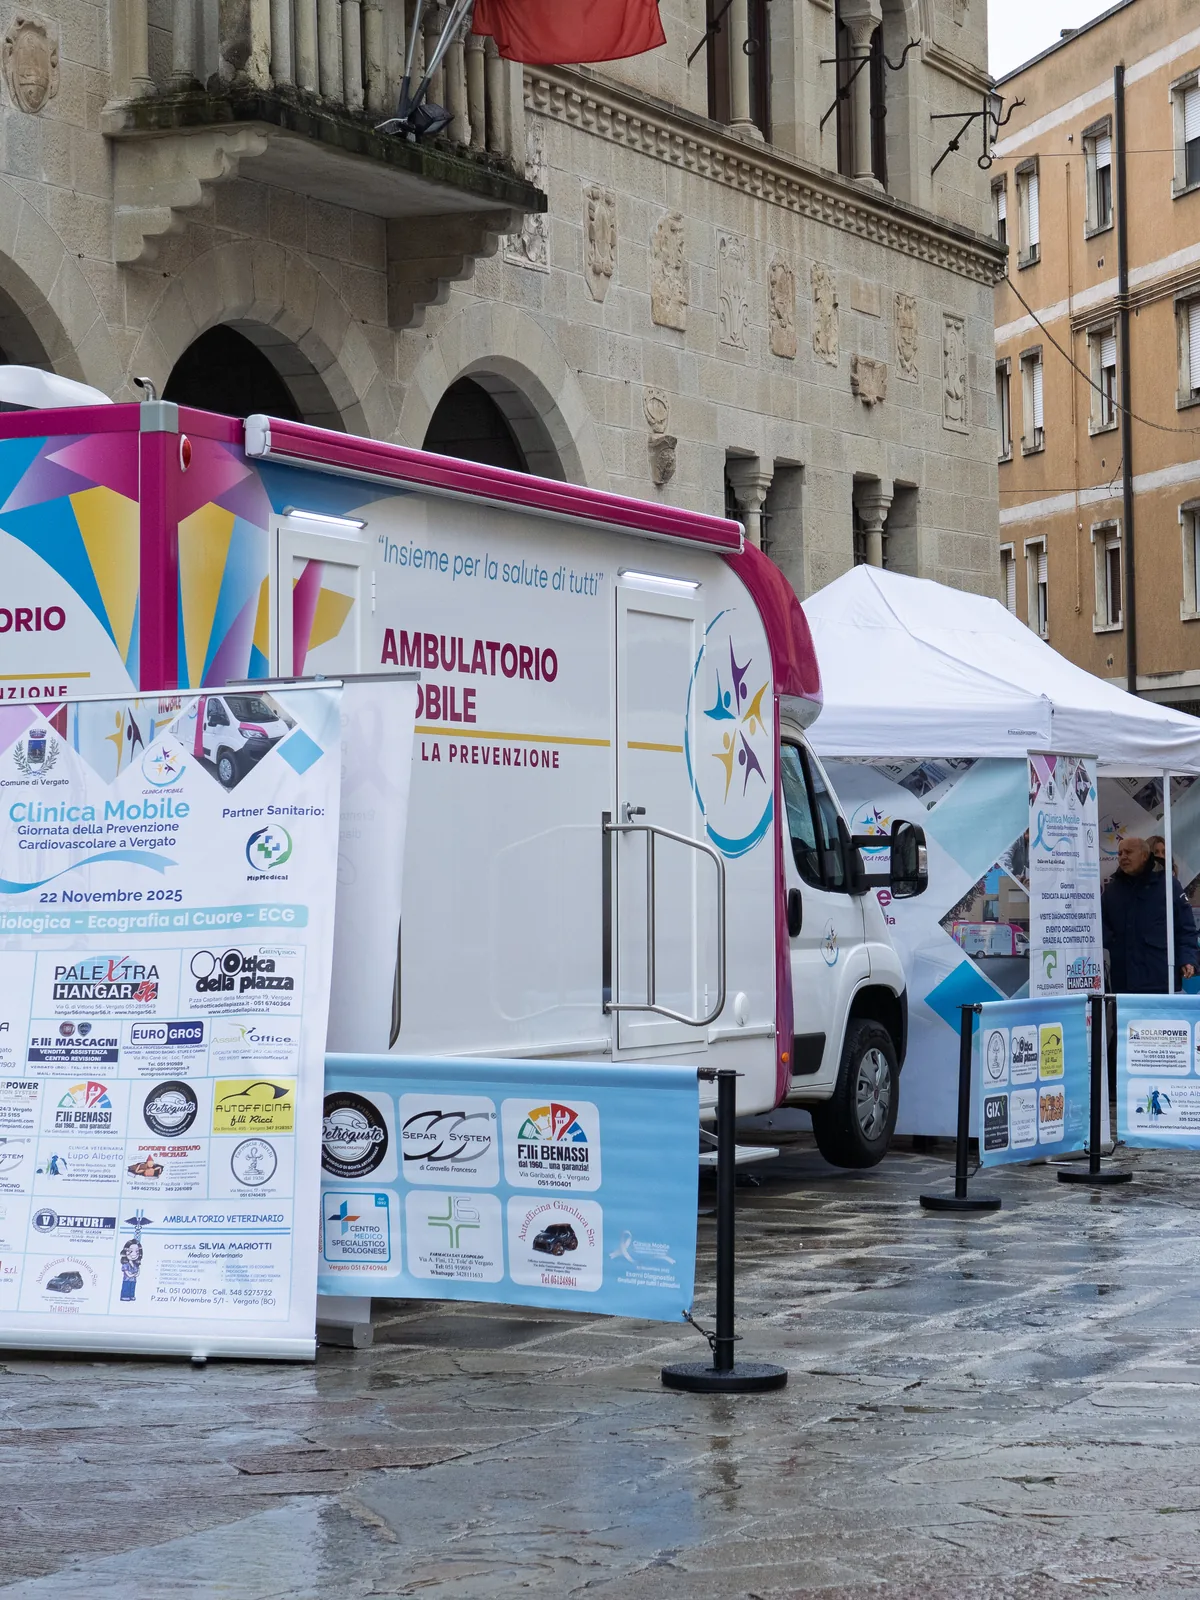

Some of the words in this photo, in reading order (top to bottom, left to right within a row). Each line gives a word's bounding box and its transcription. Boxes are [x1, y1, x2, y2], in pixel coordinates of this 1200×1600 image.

[378, 535, 449, 573] “Insieme
[453, 555, 480, 581] per
[484, 553, 499, 580] la
[502, 560, 548, 588] salute
[552, 566, 565, 591] di
[569, 571, 604, 596] tutti”
[381, 628, 558, 683] AMBULATORIO
[422, 742, 441, 762] LA
[449, 744, 560, 769] PREVENZIONE
[0, 779, 30, 787] Comune
[40, 778, 70, 787] Vergato
[9, 801, 96, 823] Clinica
[103, 797, 190, 821] Mobile
[222, 807, 264, 818] Partner
[266, 805, 325, 816] Sanitario:
[1044, 813, 1062, 824] Clinica
[1062, 814, 1081, 825] Mobile
[17, 824, 70, 836] Giornata
[72, 823, 103, 835] della
[106, 821, 179, 834] Prevenzione
[18, 838, 117, 850] Cardiovascolare
[119, 839, 127, 848] a
[129, 836, 177, 849] Vergato
[39, 892, 57, 903] 22
[62, 889, 143, 903] Novembre
[146, 889, 183, 902] 2025
[1041, 892, 1060, 900] DEDICATA
[1060, 892, 1069, 900] ALLA
[0, 914, 71, 934] iologica
[87, 913, 170, 933] Ecografia
[173, 912, 189, 926] al
[192, 910, 243, 925] Cuore
[258, 907, 295, 922] ECG
[196, 973, 235, 992] della
[239, 972, 294, 994] piazza
[1067, 977, 1093, 989] HANGAR
[55, 984, 133, 999] HANGAR
[132, 1029, 166, 1040] EURO
[168, 1028, 202, 1039] GROS
[249, 1034, 292, 1043] Office
[1140, 1029, 1188, 1037] SOLARPOWER
[31, 1037, 52, 1046] F.lli
[55, 1038, 118, 1047] MASCAGNI
[215, 1103, 292, 1113] AUTOFFICINA
[55, 1111, 73, 1122] F.lli
[74, 1111, 113, 1123] BENASSI
[402, 1131, 437, 1140] SEPAR
[449, 1133, 491, 1142] SYSTEM
[67, 1152, 89, 1161] Lupo
[92, 1152, 124, 1161] Alberto
[517, 1144, 538, 1160] F.lli
[540, 1145, 589, 1163] BENASSI
[518, 1160, 528, 1168] dal
[561, 1163, 589, 1172] garanzia!
[529, 1171, 557, 1179] Garibaldi,
[566, 1174, 590, 1182] Vergato
[537, 1179, 572, 1187] 051-910401
[162, 1215, 225, 1223] AMBULATORIO
[226, 1214, 284, 1223] VETERINARIO
[518, 1202, 552, 1242] Autofficina
[553, 1200, 589, 1228] Gianluca
[586, 1228, 595, 1247] Snc
[350, 1225, 380, 1233] CENTRO
[198, 1242, 226, 1250] SILVIA
[228, 1242, 272, 1250] MARIOTTI
[331, 1239, 386, 1247] SPECIALISTICO
[342, 1247, 387, 1255] BOLOGNESE
[474, 1259, 494, 1267] Vergato
[541, 1273, 550, 1284] Tel
[232, 1298, 259, 1306] Vergato
